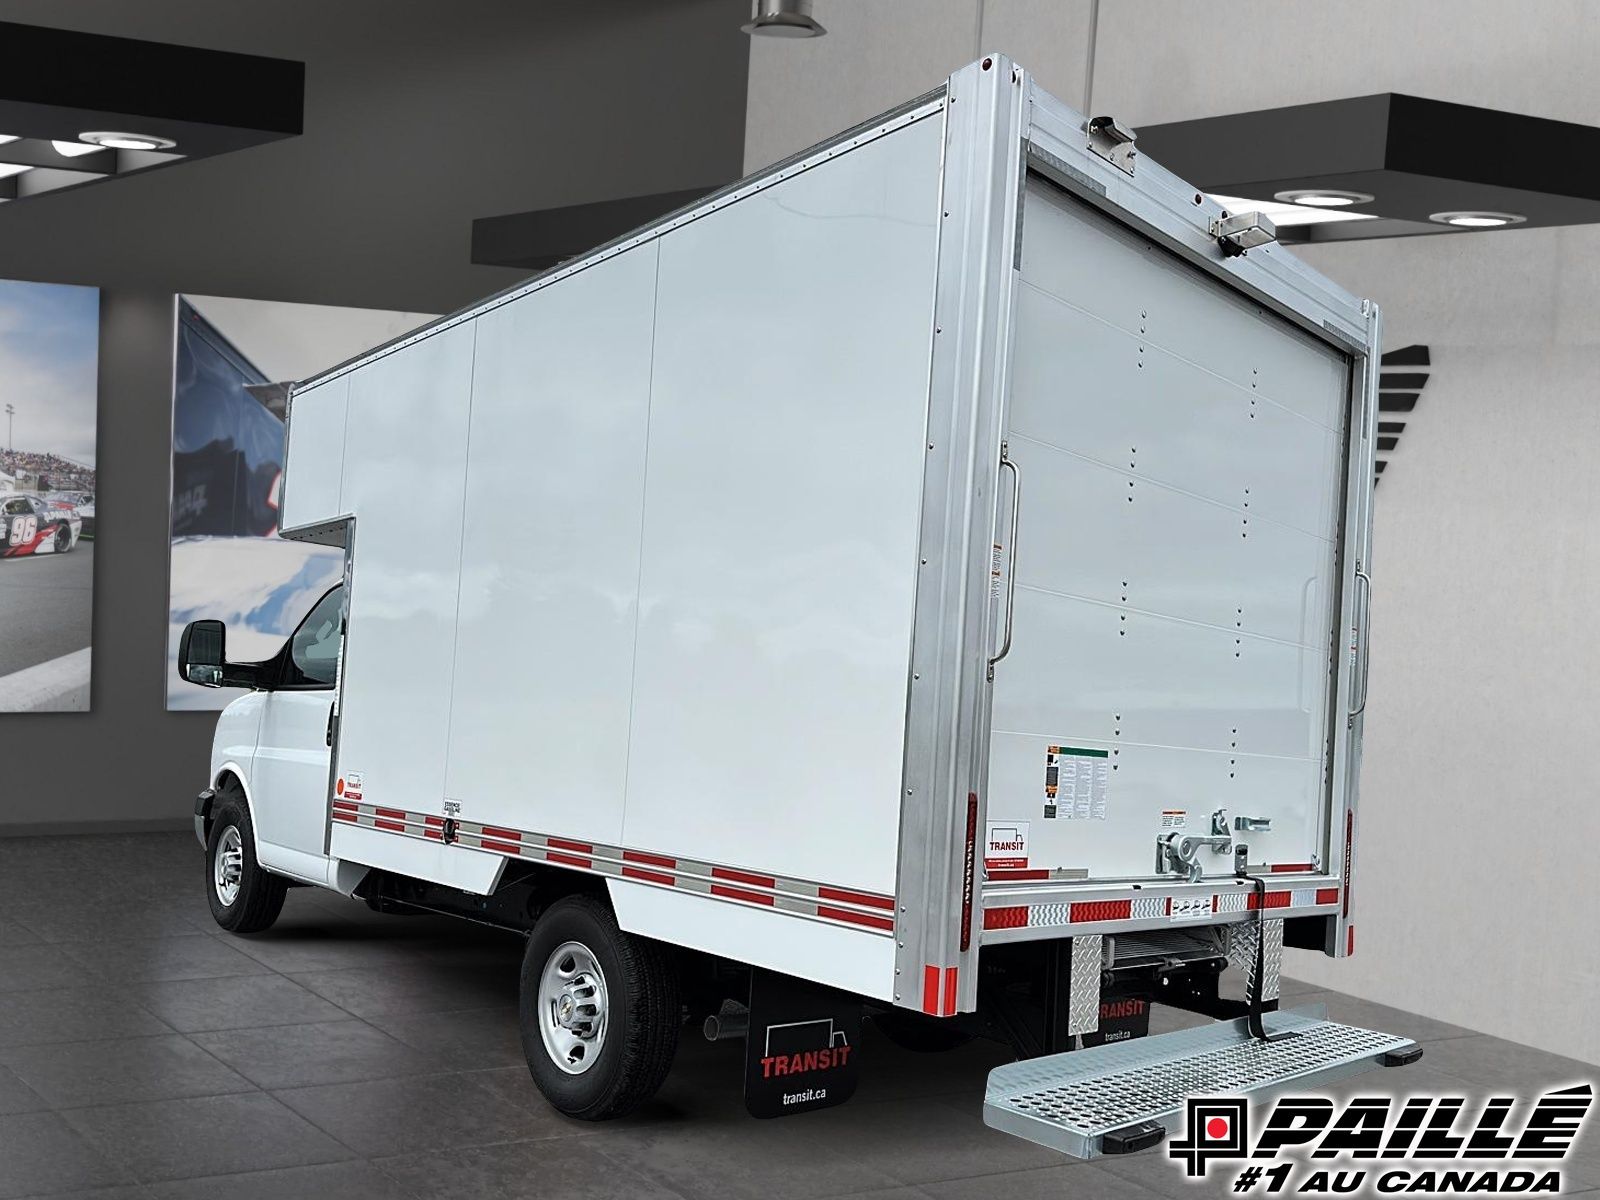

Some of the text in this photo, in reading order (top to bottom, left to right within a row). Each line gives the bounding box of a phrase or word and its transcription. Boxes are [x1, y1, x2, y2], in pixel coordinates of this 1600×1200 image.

[9, 515, 38, 546] 96
[989, 841, 1025, 851] TRANSIT
[1100, 999, 1144, 1018] RANSIT
[760, 1046, 851, 1078] TRANSIT
[783, 1088, 826, 1105] transit.ca
